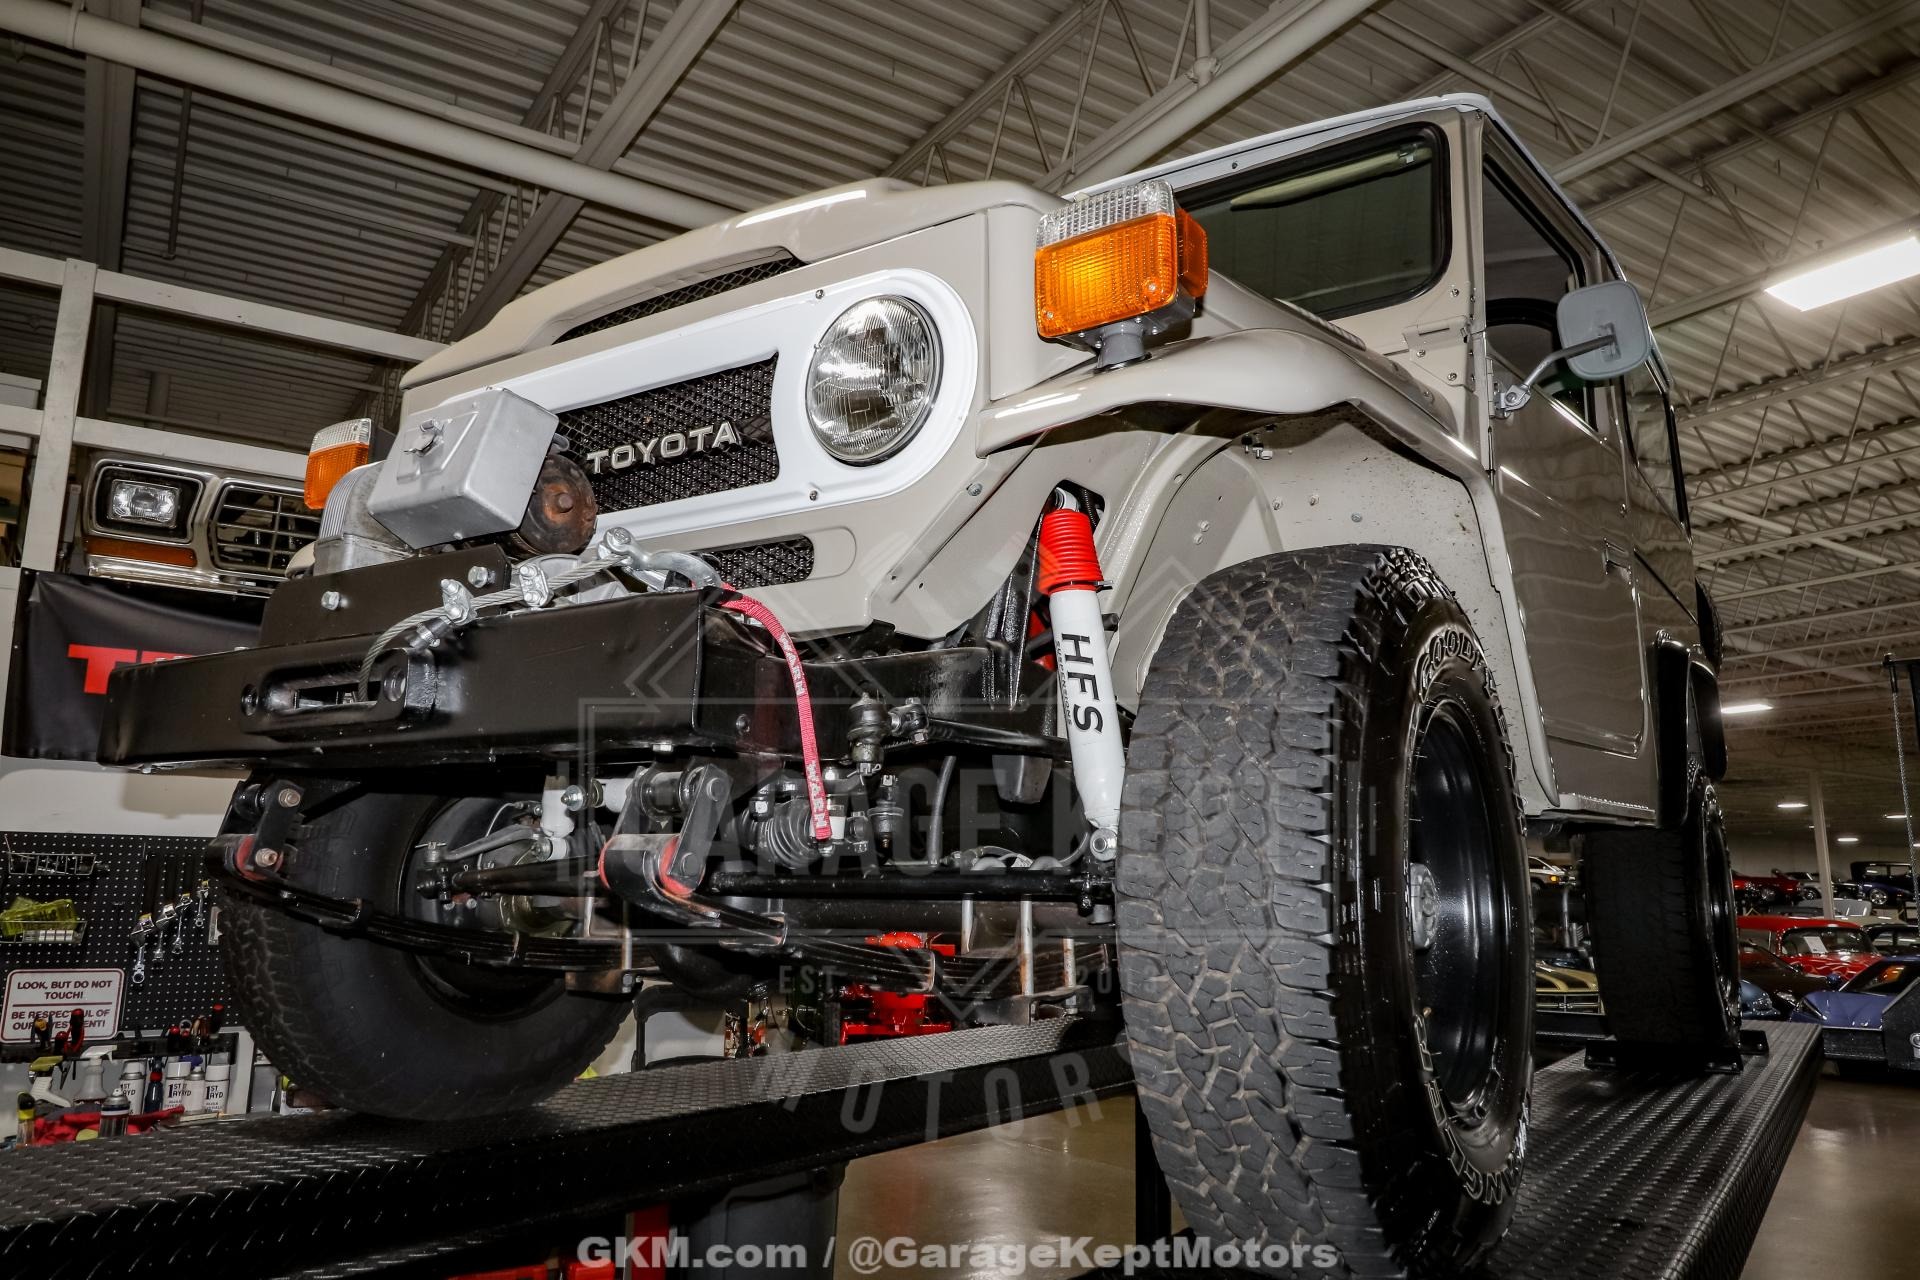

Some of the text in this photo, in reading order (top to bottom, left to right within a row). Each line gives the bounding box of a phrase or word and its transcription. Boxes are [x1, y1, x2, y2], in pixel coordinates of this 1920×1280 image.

[586, 421, 742, 474] TOYOTA
[780, 631, 806, 696] WARN
[1061, 633, 1103, 733] HFS
[1415, 628, 1529, 837] GOODYEAR
[806, 760, 828, 829] WARN
[17, 980, 112, 990] LOOK, BUT DO NOT
[44, 991, 84, 1000] TOUCH!
[11, 1011, 26, 1020] BE
[96, 1009, 110, 1017] OF
[206, 1085, 218, 1100] 1ST
